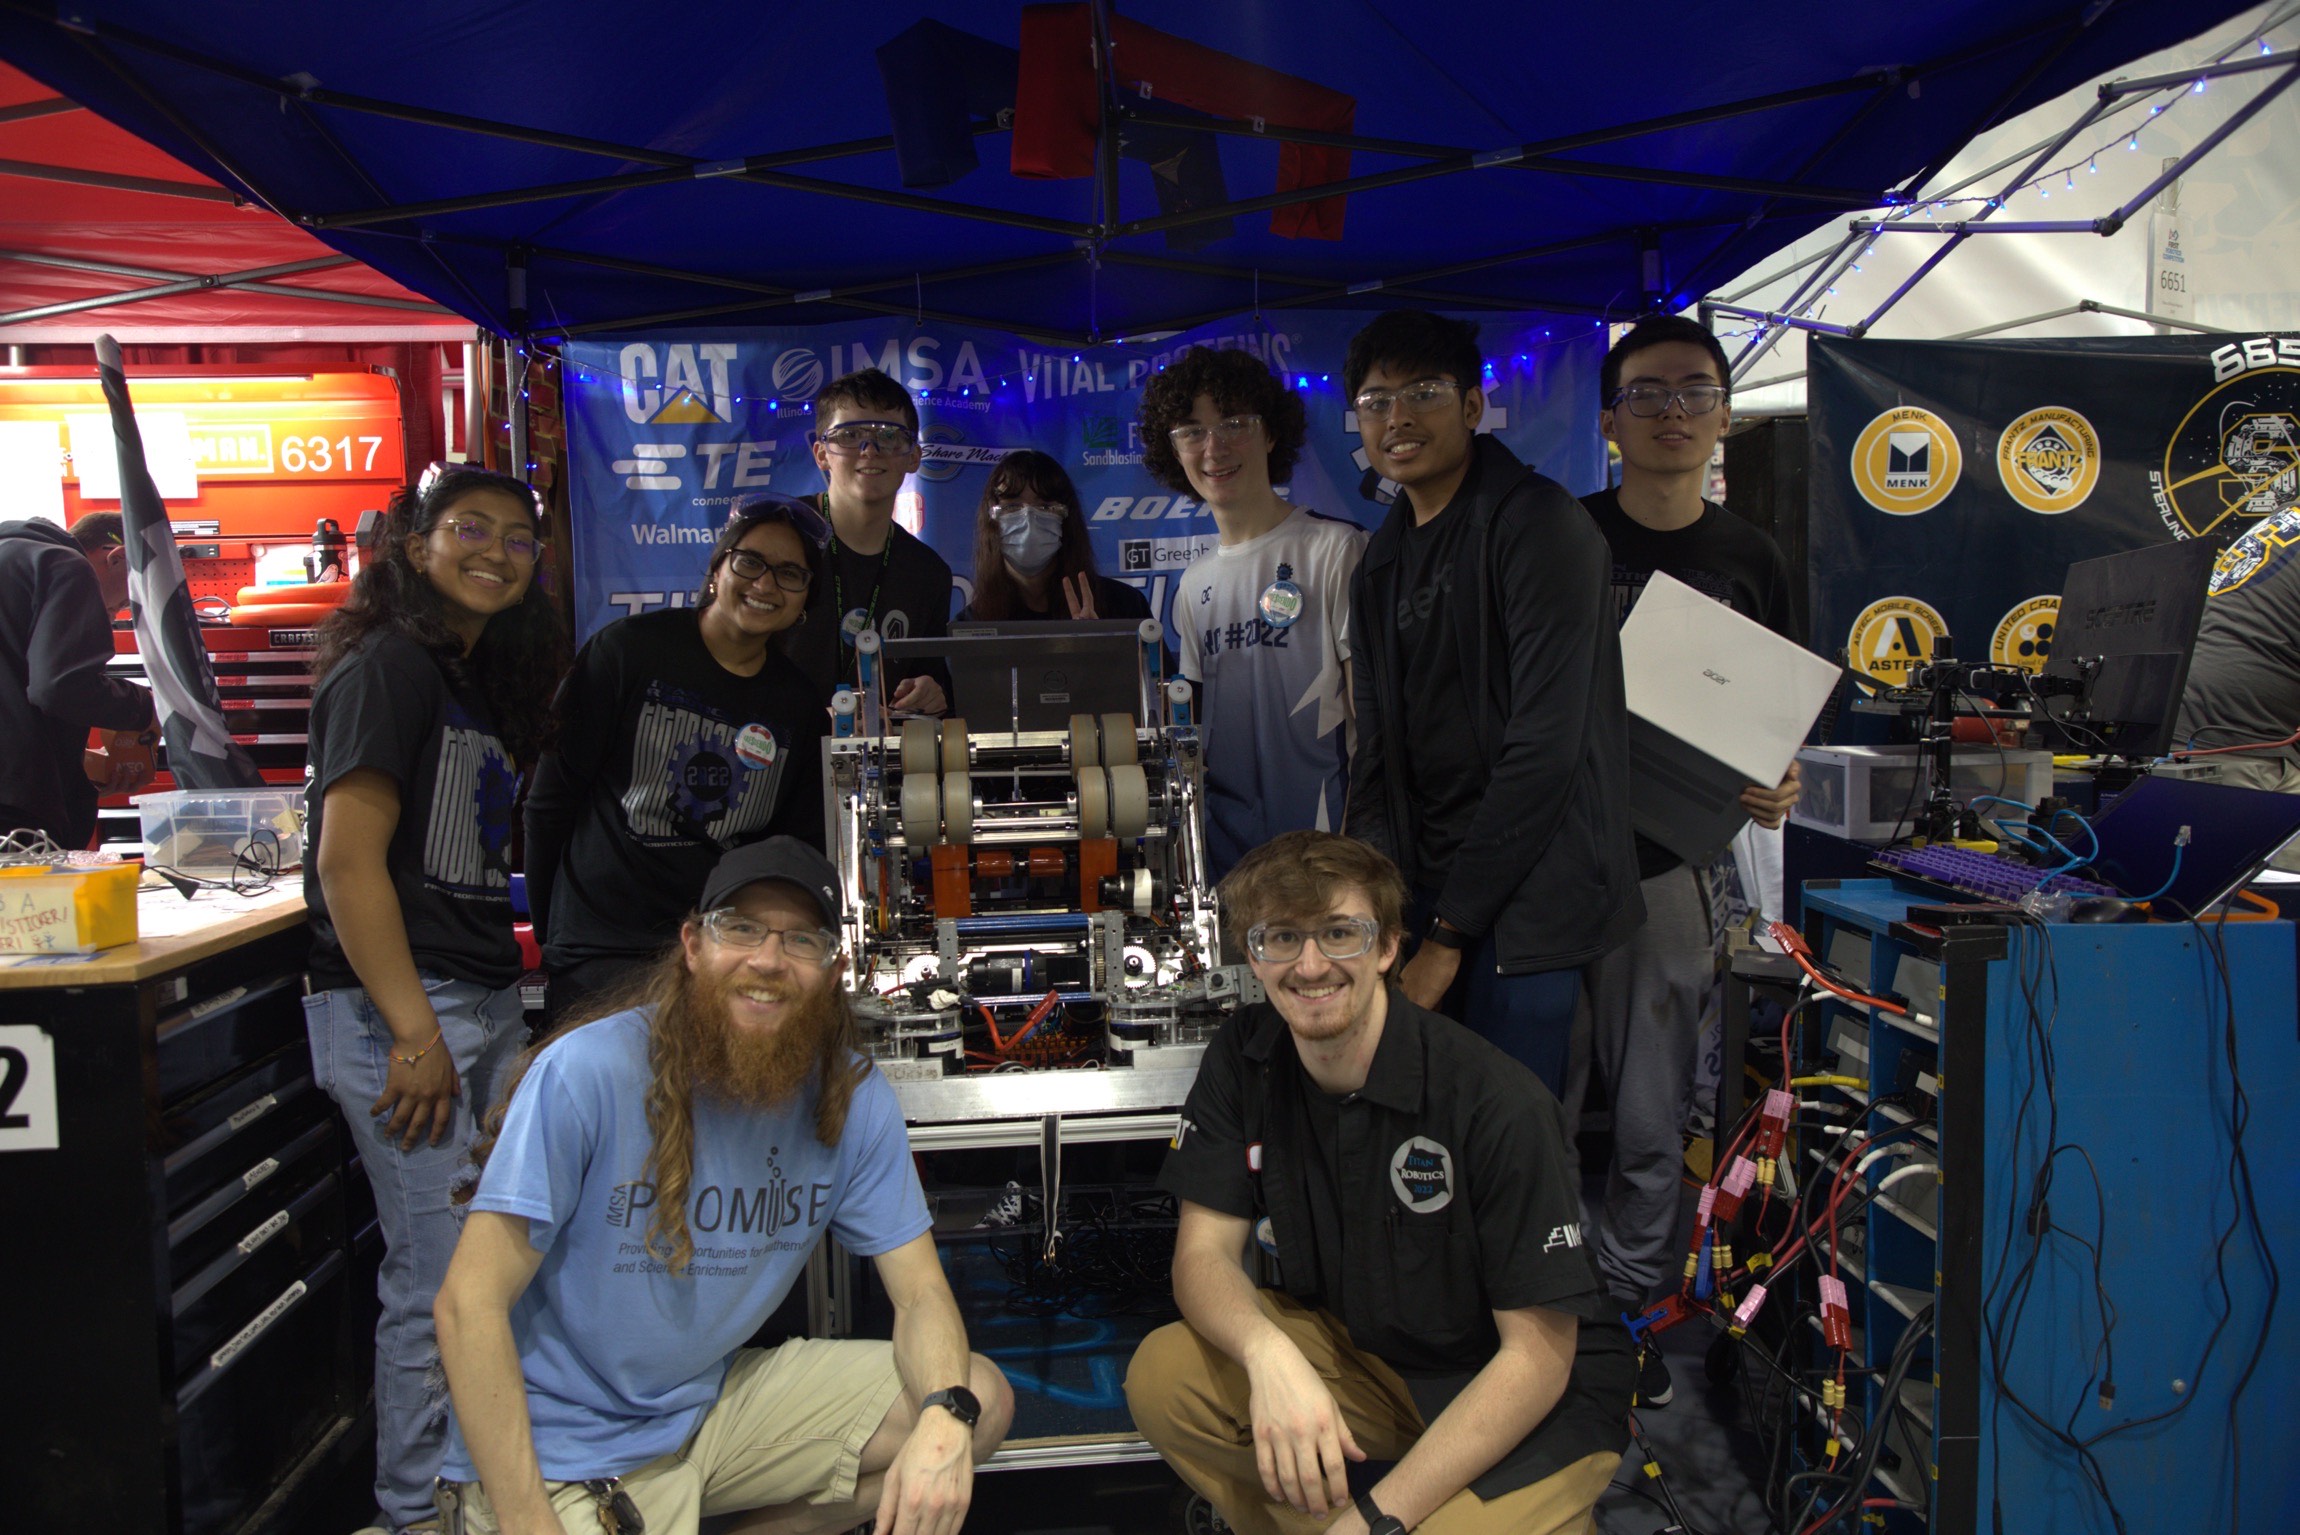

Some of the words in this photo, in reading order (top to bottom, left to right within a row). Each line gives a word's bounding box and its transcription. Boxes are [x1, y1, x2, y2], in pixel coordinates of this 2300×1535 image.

[2160, 270, 2186, 293] 6651
[830, 336, 991, 394] IMSA
[1018, 348, 1115, 404] VITAL
[619, 342, 737, 424] CAT
[776, 406, 812, 419] Illinois
[944, 397, 991, 413] Academy
[1892, 410, 1927, 422] MENK
[2003, 422, 2027, 460] FRANTZ
[2030, 412, 2095, 459] MANUFACTURING
[281, 436, 382, 472] 6317
[695, 440, 776, 490] TE
[1082, 449, 1144, 466] Sandblastin
[2016, 450, 2084, 469] FRANTZ
[1886, 478, 1928, 488] MENK
[631, 523, 723, 545] Walmar
[1126, 543, 1149, 564] GT
[1224, 617, 1288, 649] #2022
[1854, 614, 1872, 648] ASTEC
[1873, 602, 1911, 615] MOBILE
[1995, 608, 2026, 650] UNITED
[2029, 599, 2058, 611] CRA
[1702, 668, 1731, 686] acer
[686, 766, 730, 786] 2022
[1407, 1154, 1435, 1168] TITAN
[1401, 1167, 1445, 1181] ROBOTICS
[1413, 1184, 1435, 1195] 2022
[606, 1184, 627, 1228] IMSA
[625, 1178, 833, 1237] POMISE
[749, 1246, 764, 1258] for
[613, 1261, 636, 1274] and
[687, 1262, 749, 1277] Enrichment
